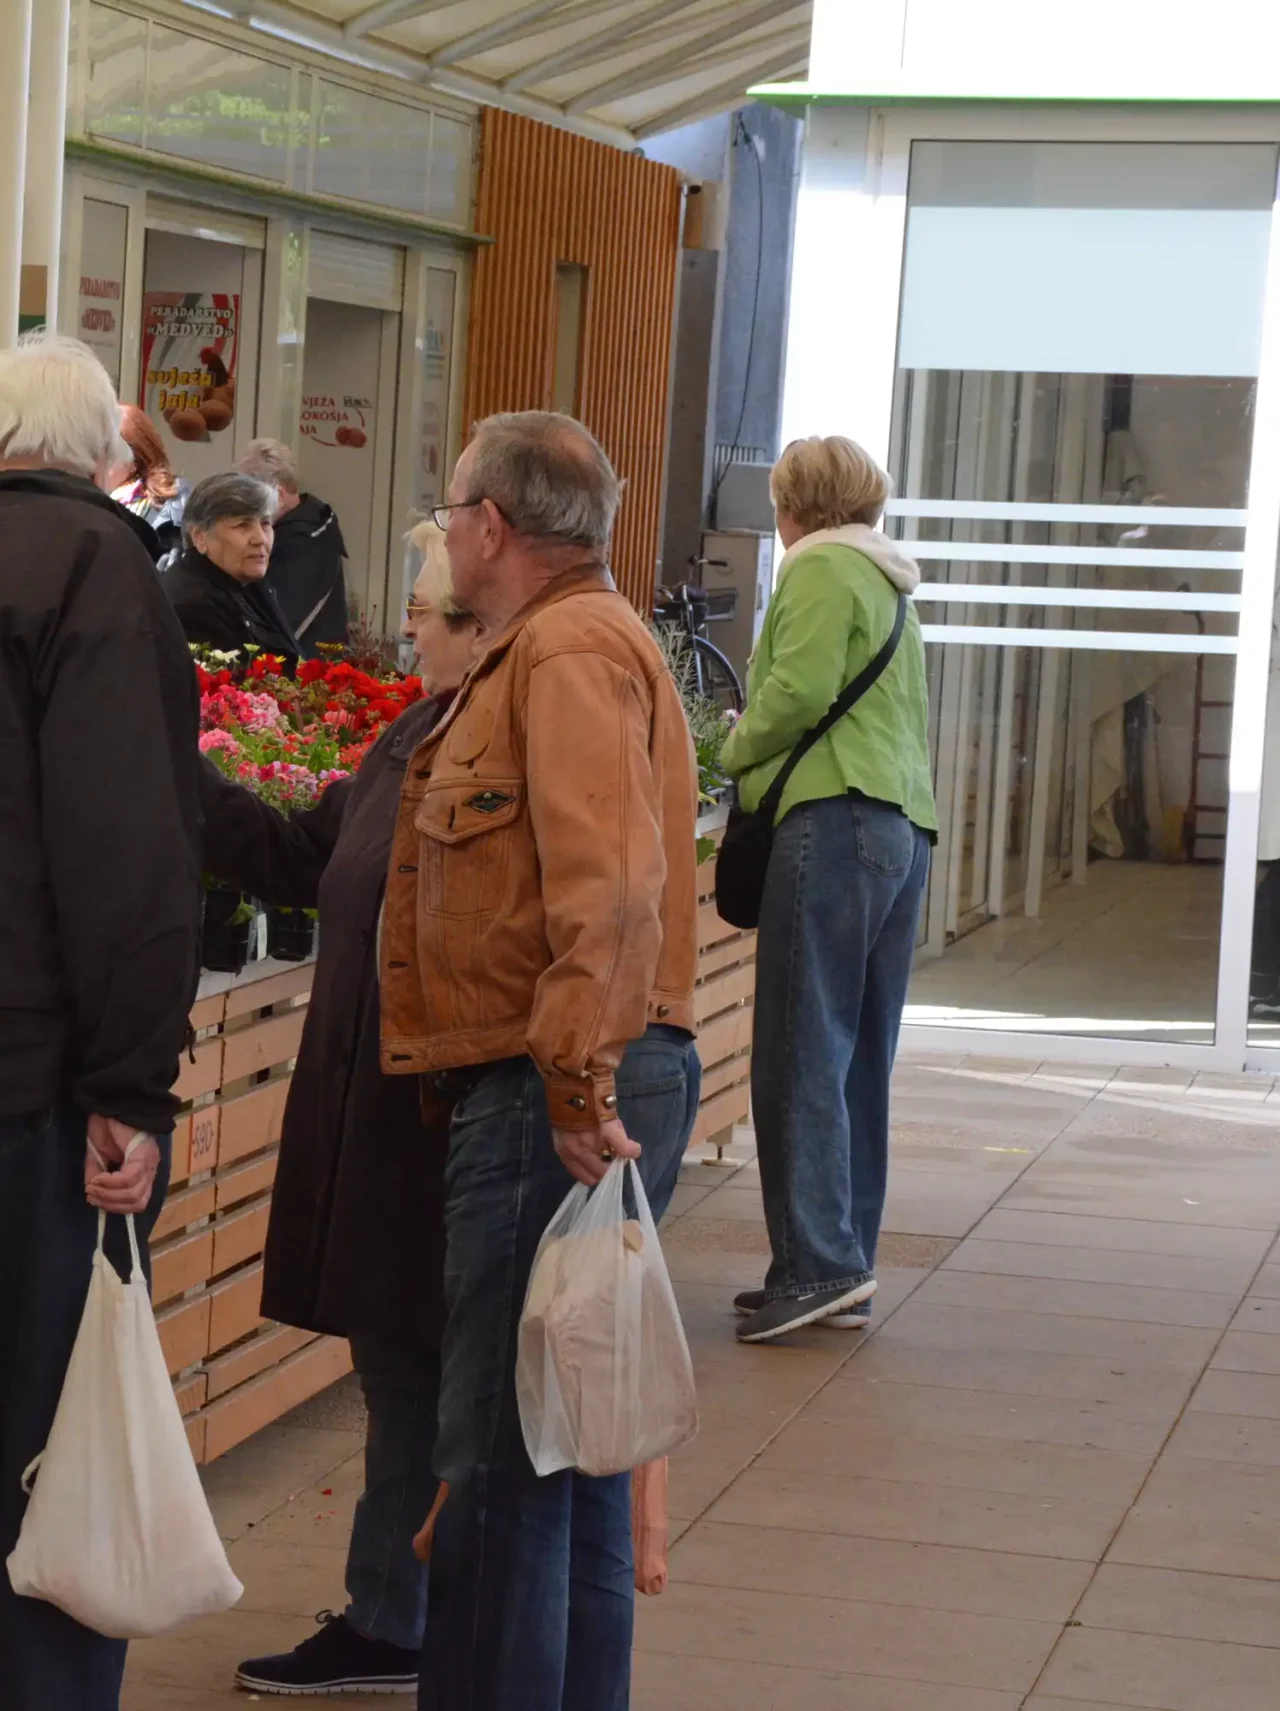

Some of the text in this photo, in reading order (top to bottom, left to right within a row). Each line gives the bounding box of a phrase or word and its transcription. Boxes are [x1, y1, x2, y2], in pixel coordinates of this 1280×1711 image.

[150, 305, 234, 319] PERADARSTVO
[158, 390, 201, 412] jaja
[302, 394, 336, 408] VJEŽA
[300, 410, 349, 424] OKOŠJA
